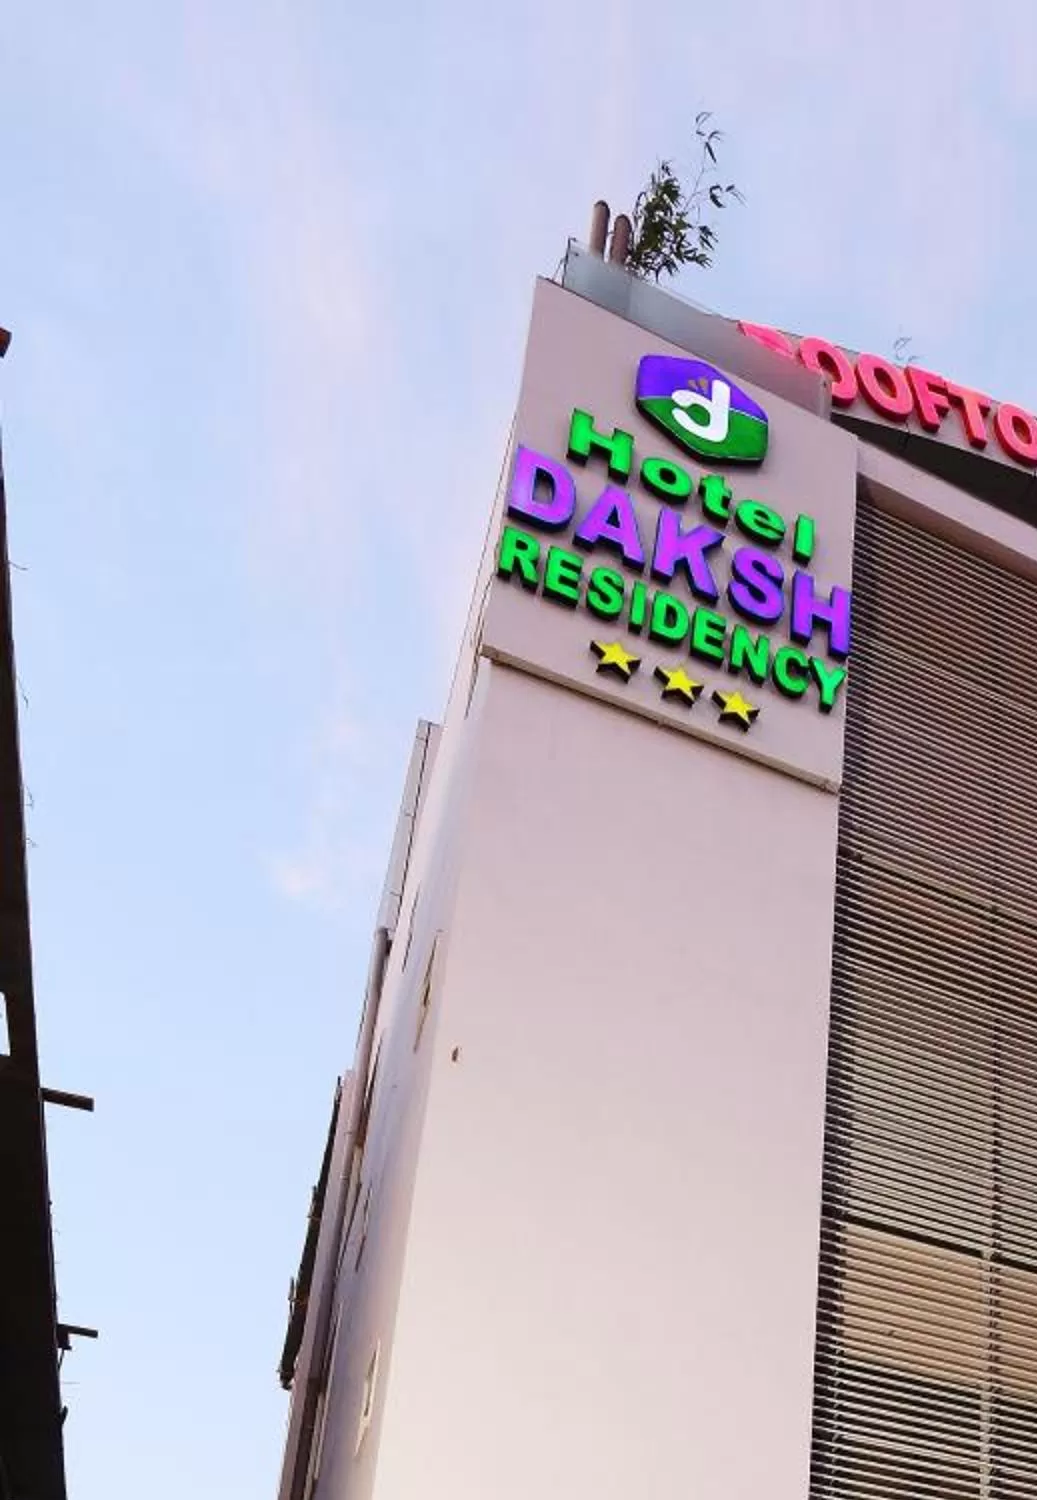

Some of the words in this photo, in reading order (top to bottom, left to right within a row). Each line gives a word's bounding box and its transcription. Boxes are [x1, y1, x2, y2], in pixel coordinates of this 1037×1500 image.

[507, 443, 852, 659] DAKSH
[567, 407, 816, 566] Hotel
[498, 525, 847, 713] RESIDENCY
